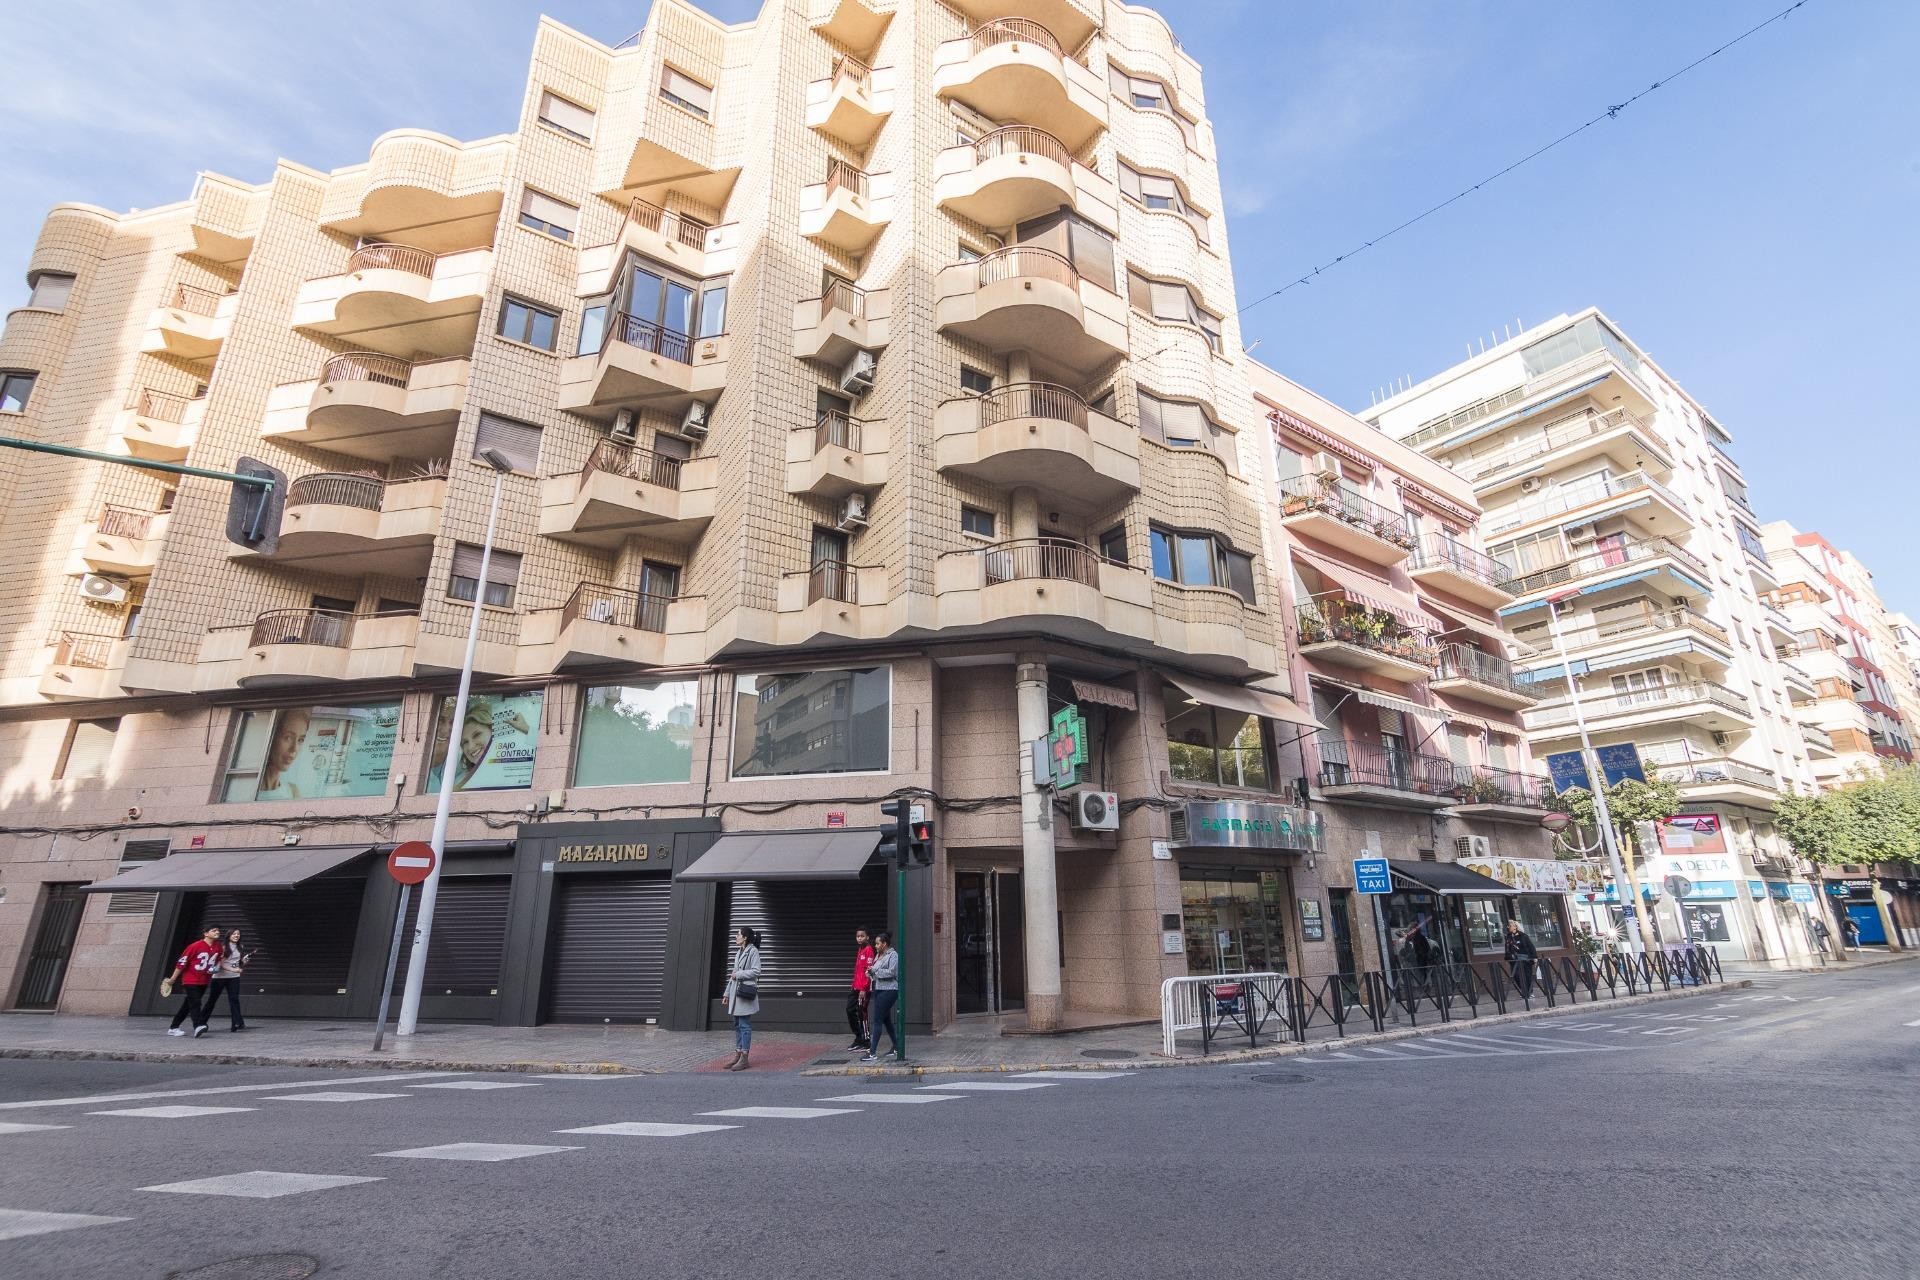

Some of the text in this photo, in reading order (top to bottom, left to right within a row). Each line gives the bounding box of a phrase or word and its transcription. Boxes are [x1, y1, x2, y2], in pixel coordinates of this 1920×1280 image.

[1075, 684, 1109, 702] SCALA
[1200, 817, 1273, 832] FARMACIA
[558, 843, 649, 863] MAZARINO
[1686, 860, 1730, 871] DELTA
[1361, 880, 1385, 889] TAXI
[194, 952, 219, 971] 34
